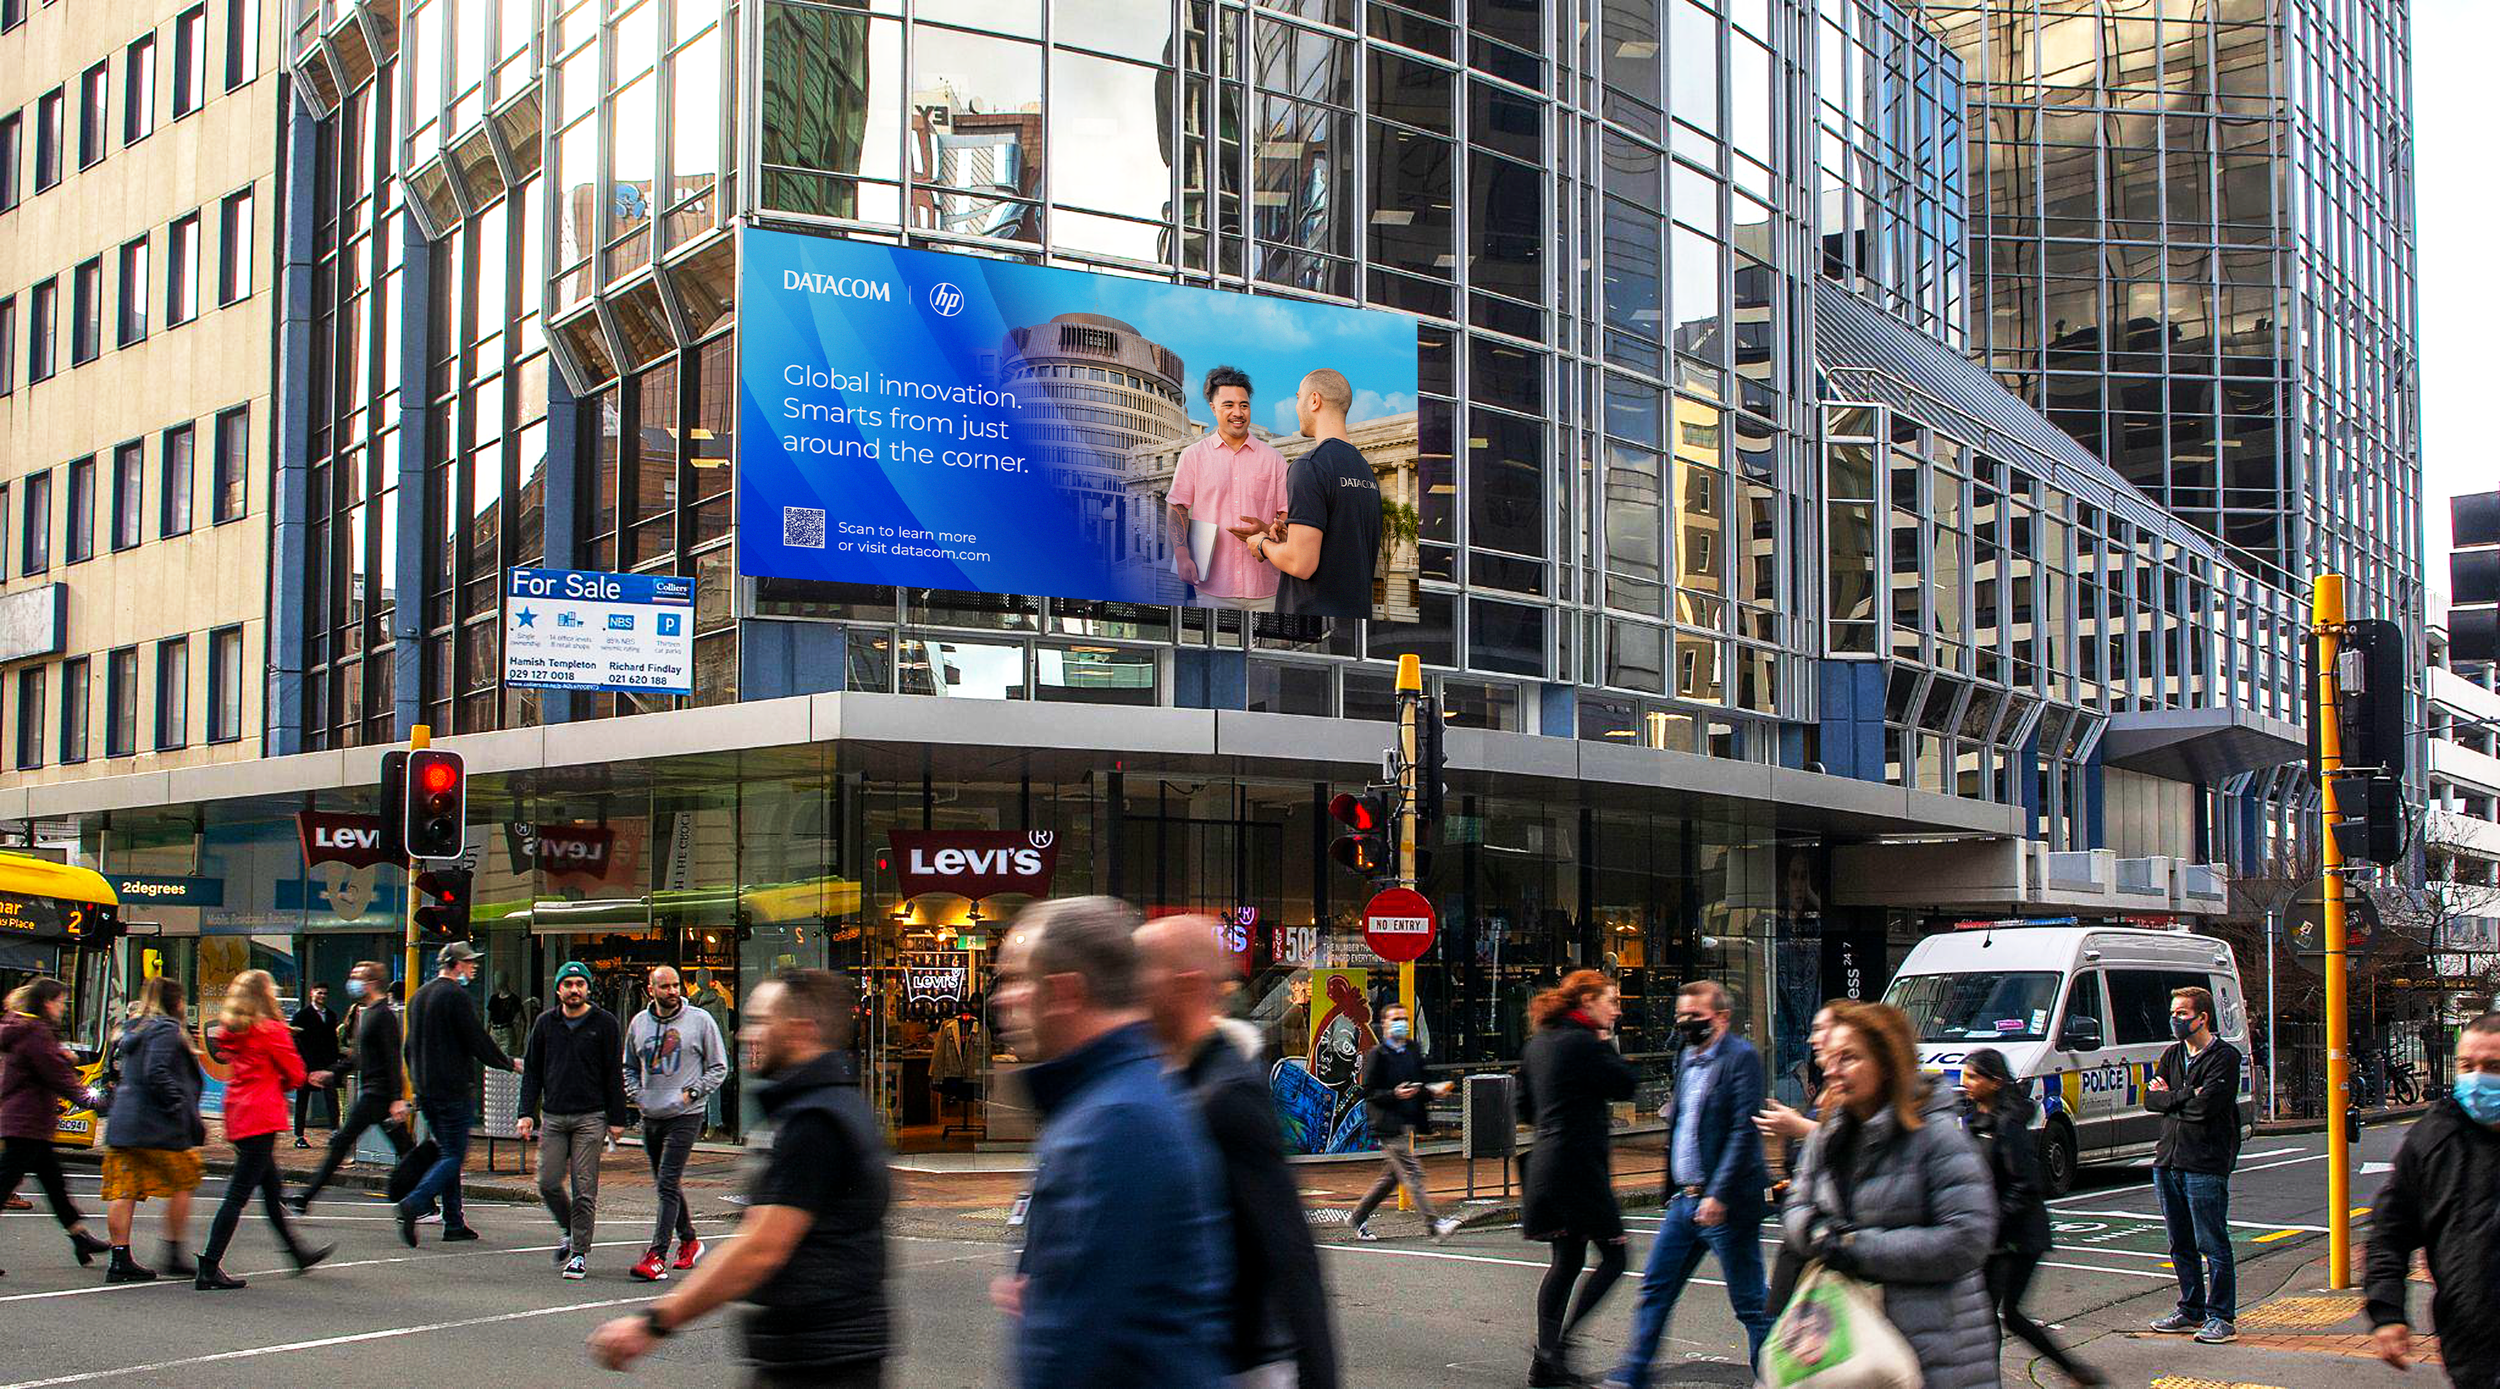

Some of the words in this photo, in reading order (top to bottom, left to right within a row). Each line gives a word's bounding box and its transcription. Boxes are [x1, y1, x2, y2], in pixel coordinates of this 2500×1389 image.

[783, 270, 890, 302] DATACOM
[933, 283, 962, 316] hp
[783, 363, 869, 394] Global
[879, 372, 1023, 410] innovation.
[783, 397, 882, 427] Smarts
[889, 406, 953, 434] from
[959, 413, 1009, 441] just
[783, 434, 880, 460] around
[888, 441, 934, 464] the
[941, 449, 1029, 474] corner.
[838, 520, 875, 536] Scan
[878, 525, 894, 539] to
[898, 525, 935, 541] learn
[938, 530, 977, 544] more
[838, 541, 853, 552] or
[857, 541, 887, 555] visit
[890, 543, 991, 562] datacom.com
[513, 570, 557, 595] For
[565, 574, 621, 600] Sale
[656, 582, 688, 592] Colliers
[609, 616, 633, 629] NBS
[509, 656, 546, 667] Hamish
[548, 658, 597, 671] Templeton
[609, 661, 645, 672] Richard
[647, 663, 682, 676] Findlay
[509, 669, 529, 679] 029
[531, 670, 548, 679] 127
[550, 671, 575, 681] 0018
[608, 674, 626, 683] 021
[629, 675, 648, 684] 620
[651, 676, 667, 685] 188
[315, 826, 380, 850] Lev
[122, 881, 186, 897] 2degrees
[9, 918, 35, 931] Place
[67, 911, 82, 934] 2
[1376, 919, 1388, 930] NO
[1393, 920, 1421, 931] ENTRY
[2082, 1068, 2124, 1094] POLICE
